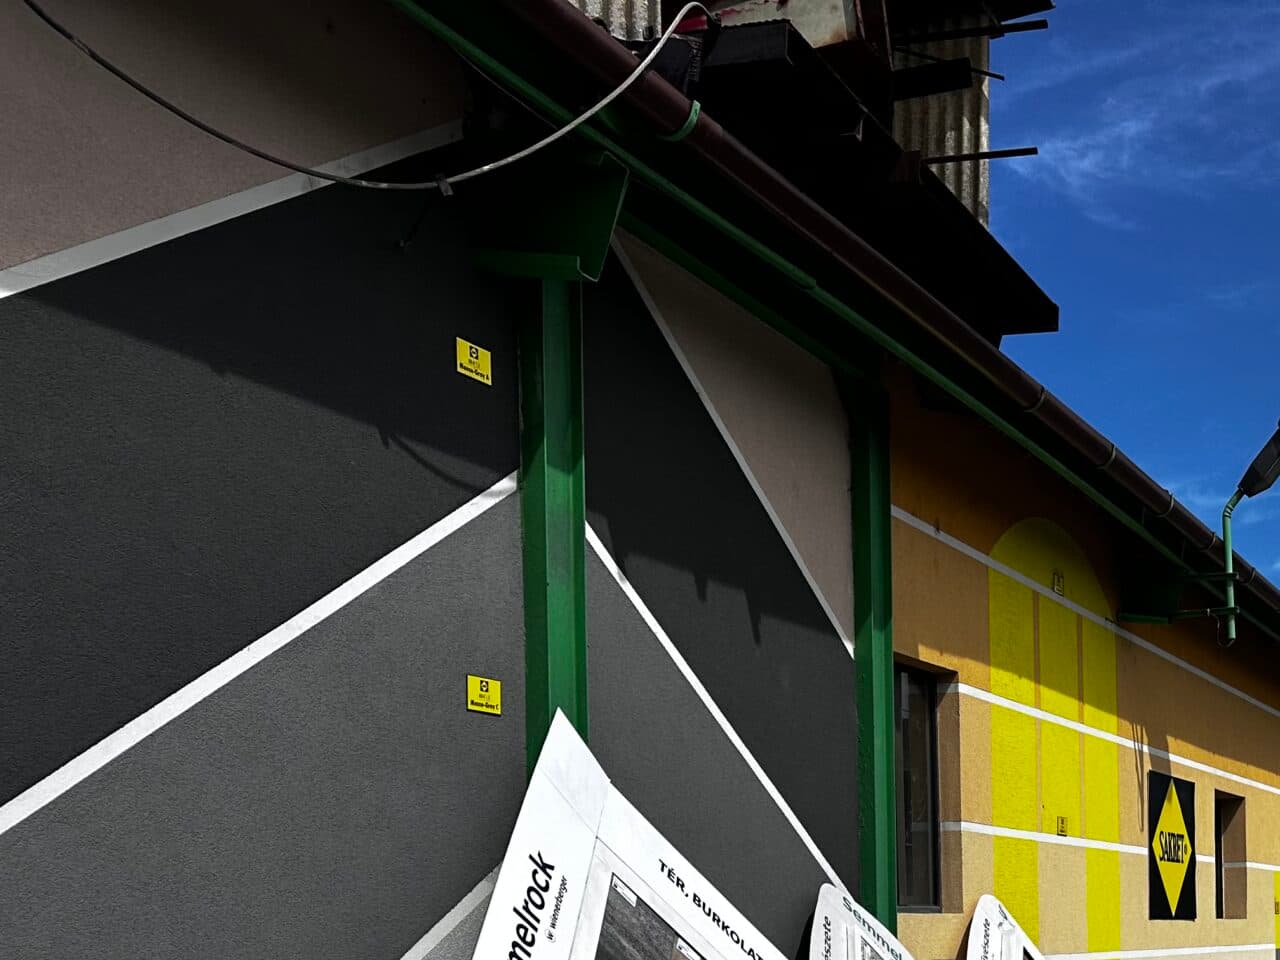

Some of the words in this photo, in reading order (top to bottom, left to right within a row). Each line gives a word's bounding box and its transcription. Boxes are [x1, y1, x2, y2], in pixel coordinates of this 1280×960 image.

[1159, 831, 1184, 864] SAKRET
[658, 859, 689, 897] TÉR,
[550, 875, 568, 930] wienerberger
